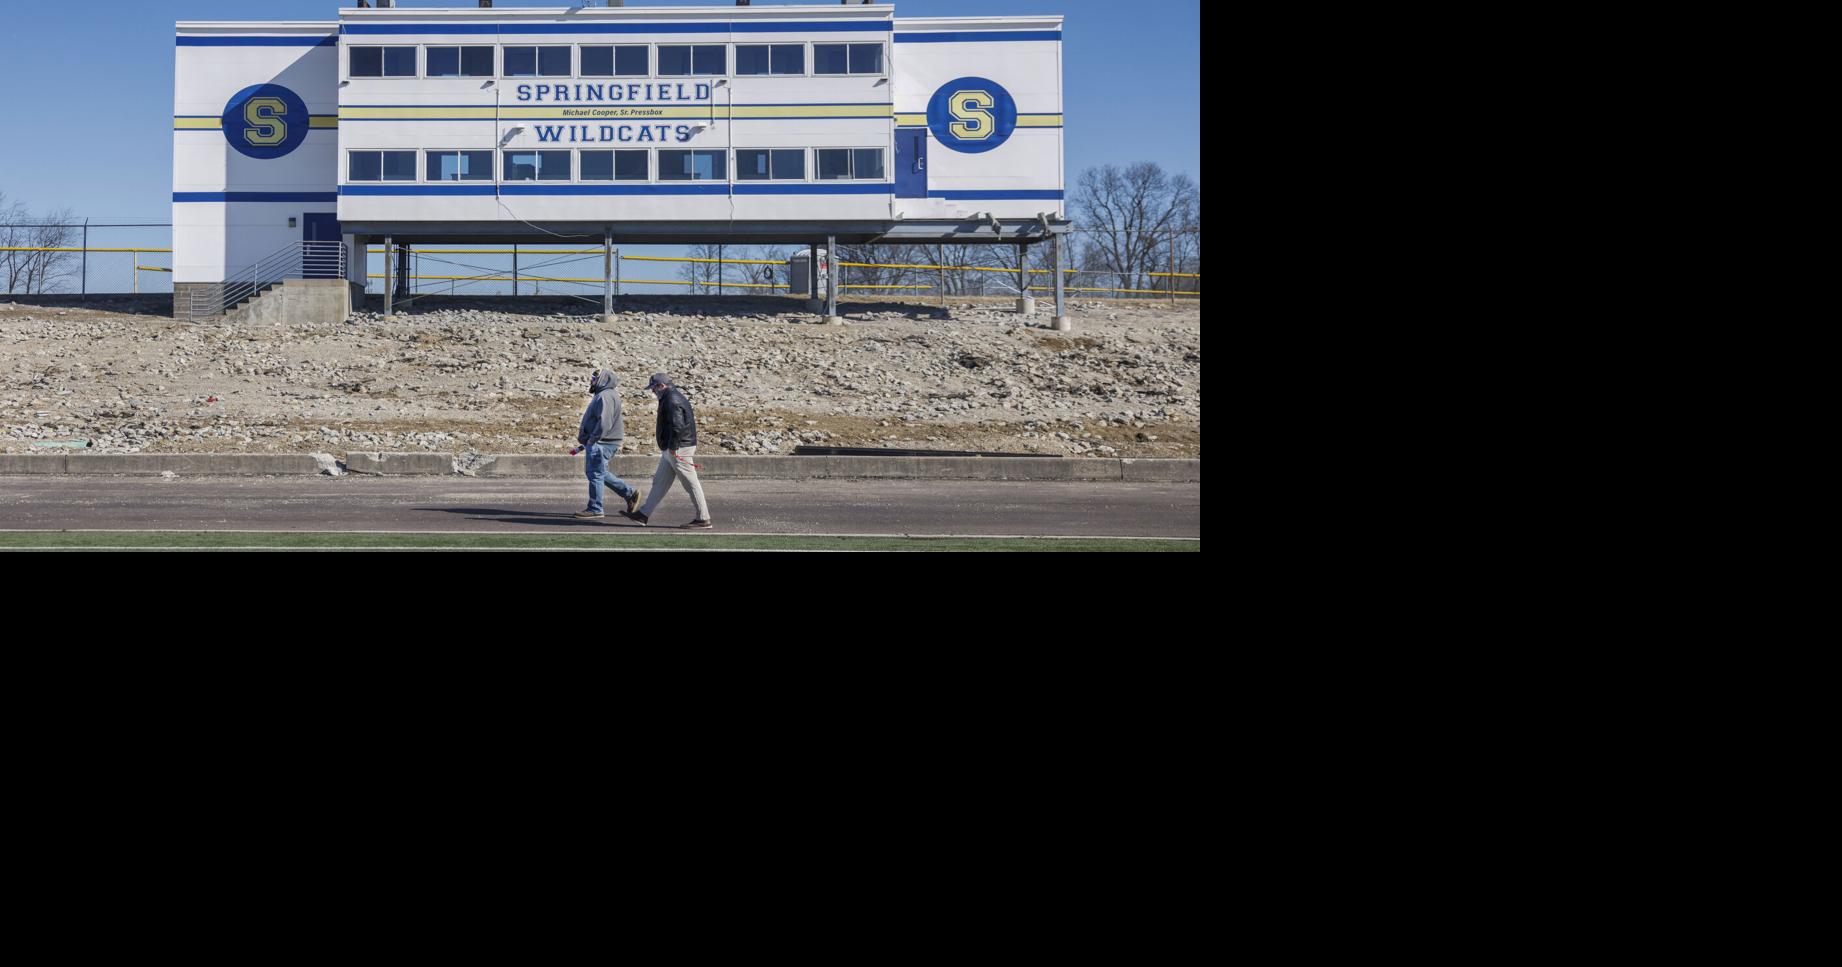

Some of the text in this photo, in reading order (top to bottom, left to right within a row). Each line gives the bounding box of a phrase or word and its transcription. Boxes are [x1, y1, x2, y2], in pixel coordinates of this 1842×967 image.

[517, 84, 710, 101] SPRINGFIELD
[243, 96, 288, 147] S
[592, 109, 618, 117] Cooper,
[948, 89, 995, 141] S
[535, 125, 691, 142] WILDCATS
